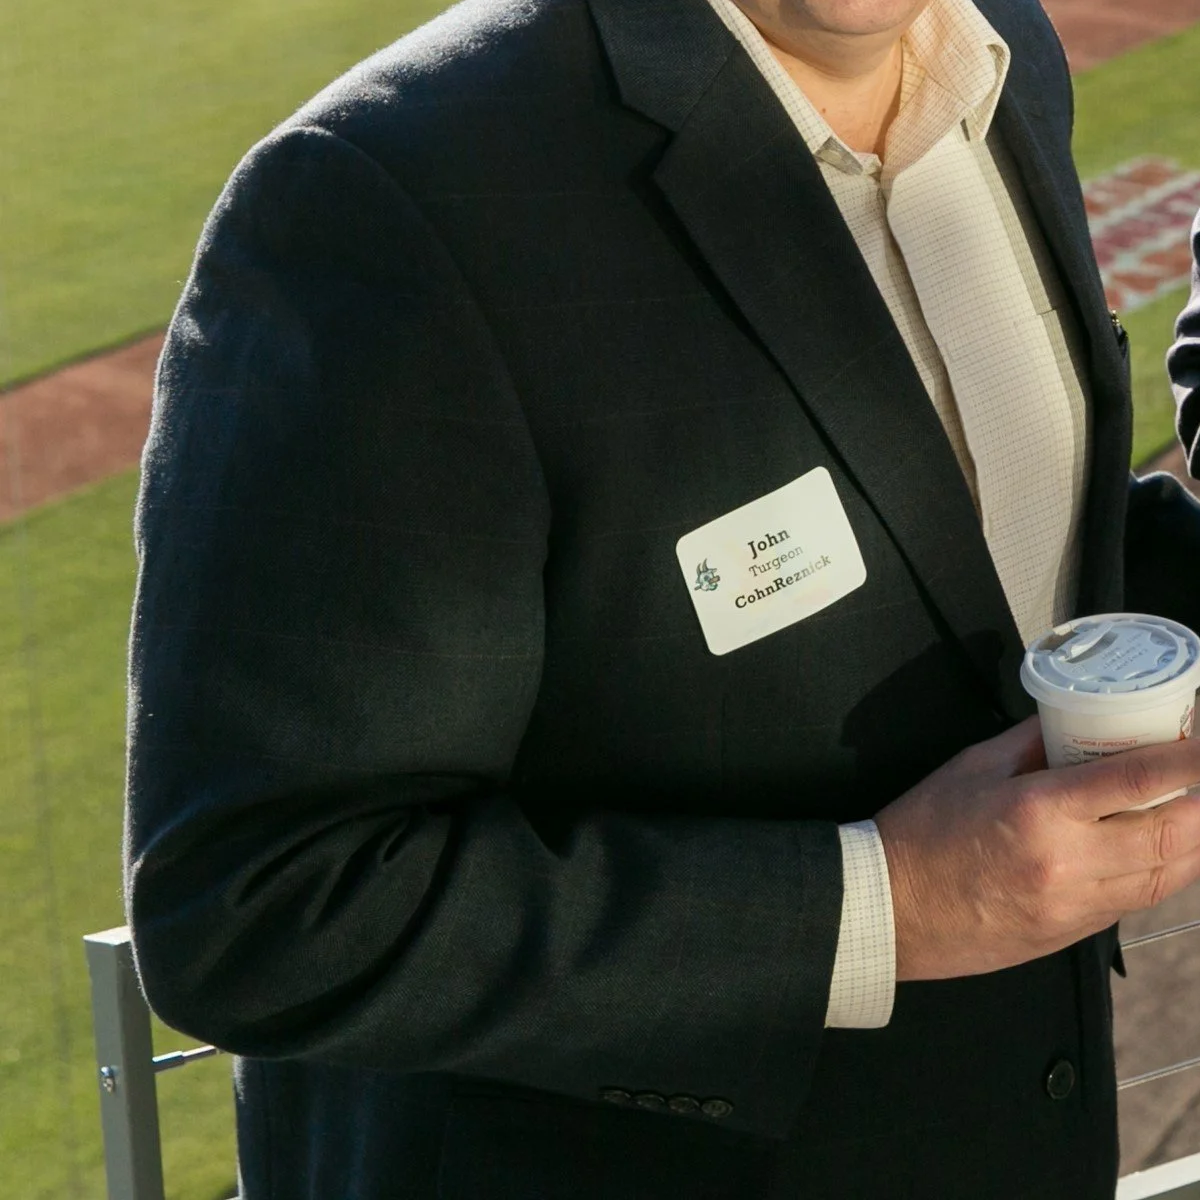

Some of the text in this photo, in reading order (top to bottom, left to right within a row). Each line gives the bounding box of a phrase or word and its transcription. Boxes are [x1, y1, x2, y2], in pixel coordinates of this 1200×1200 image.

[747, 529, 791, 560] John
[748, 546, 804, 578] Turgeon
[734, 555, 832, 609] CohnReznick
